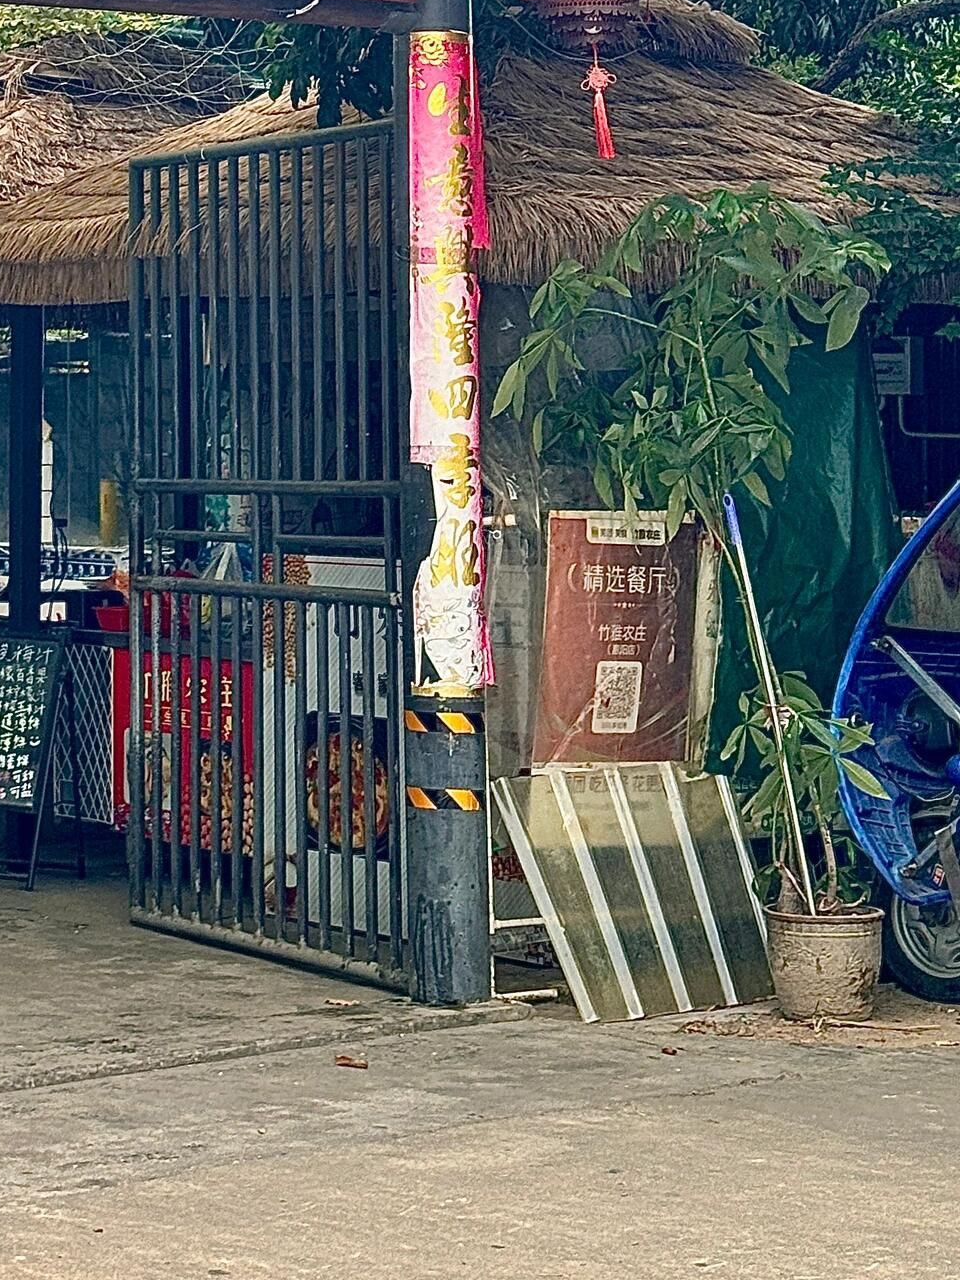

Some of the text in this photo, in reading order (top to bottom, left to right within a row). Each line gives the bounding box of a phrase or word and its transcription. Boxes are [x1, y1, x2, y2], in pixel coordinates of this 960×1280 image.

[583, 563, 668, 594] 精选餐厅
[598, 624, 648, 641] 竹雅农庄
